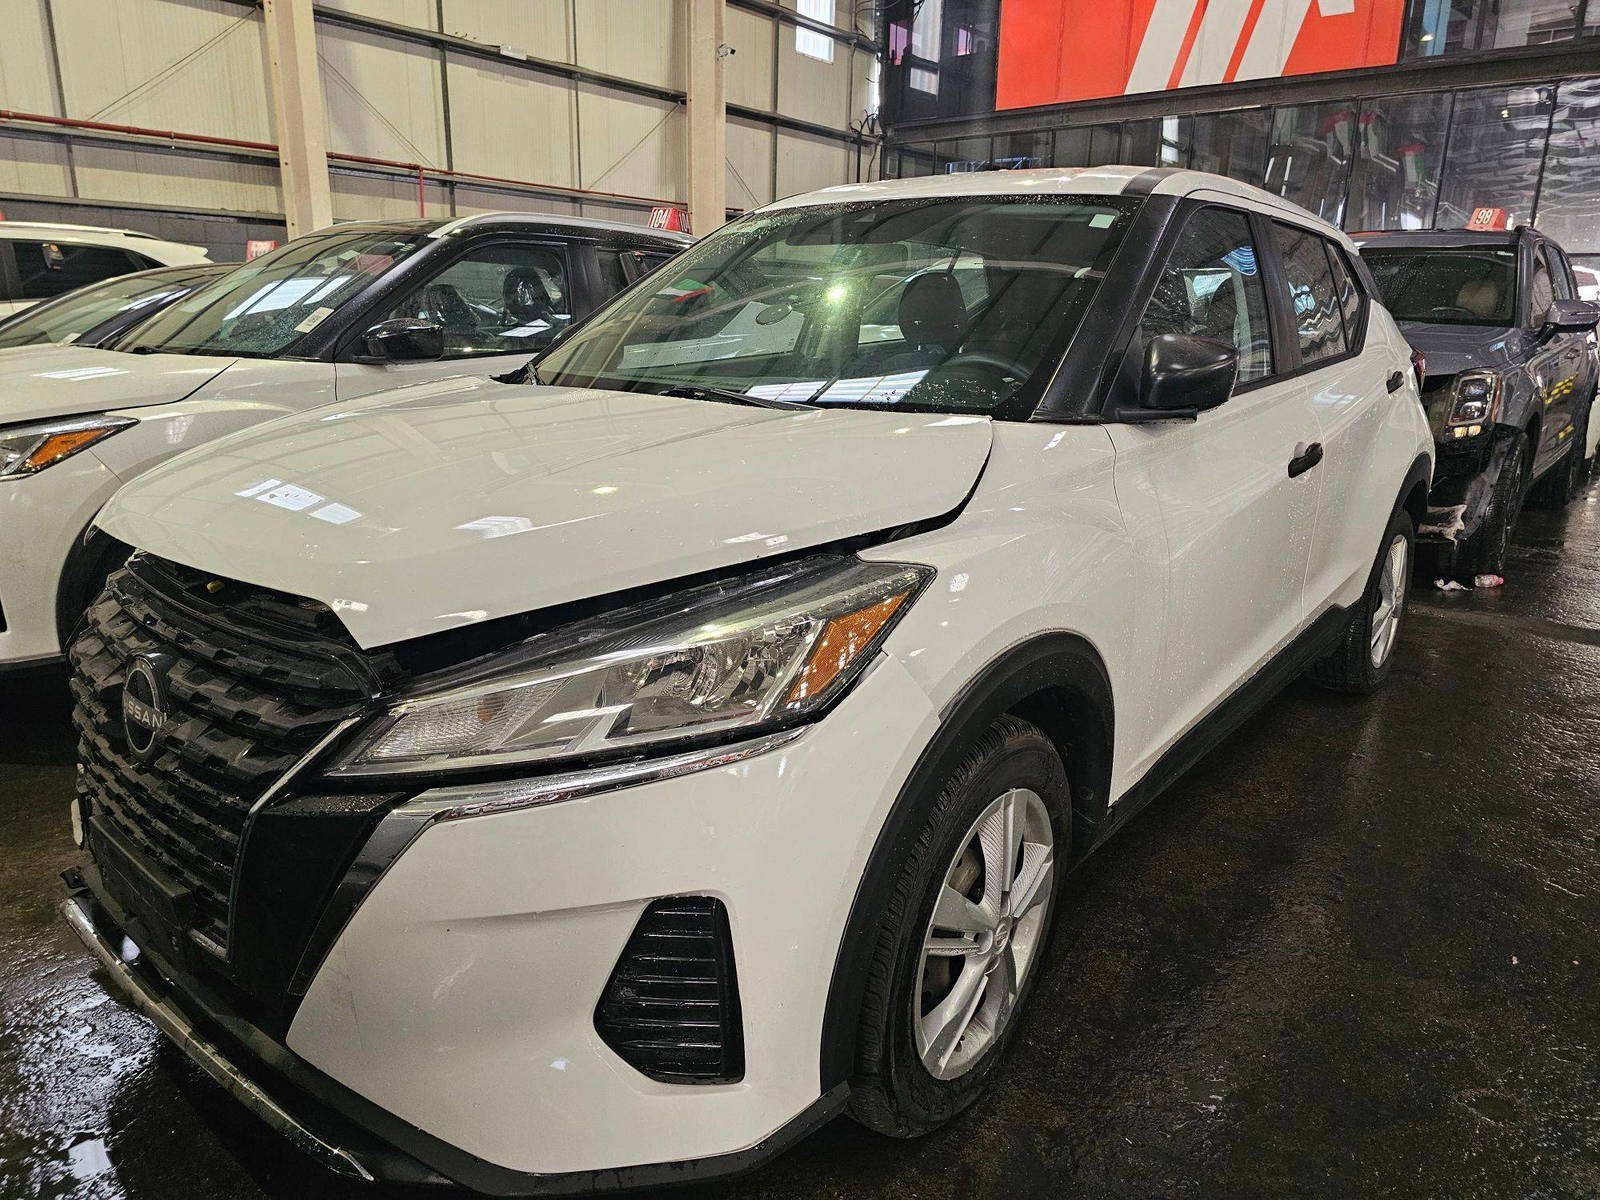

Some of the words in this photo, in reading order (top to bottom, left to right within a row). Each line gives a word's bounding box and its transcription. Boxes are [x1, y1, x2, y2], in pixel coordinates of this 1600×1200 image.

[650, 208, 669, 228] 104
[1475, 209, 1493, 224] 98
[125, 698, 162, 729] SSAN
